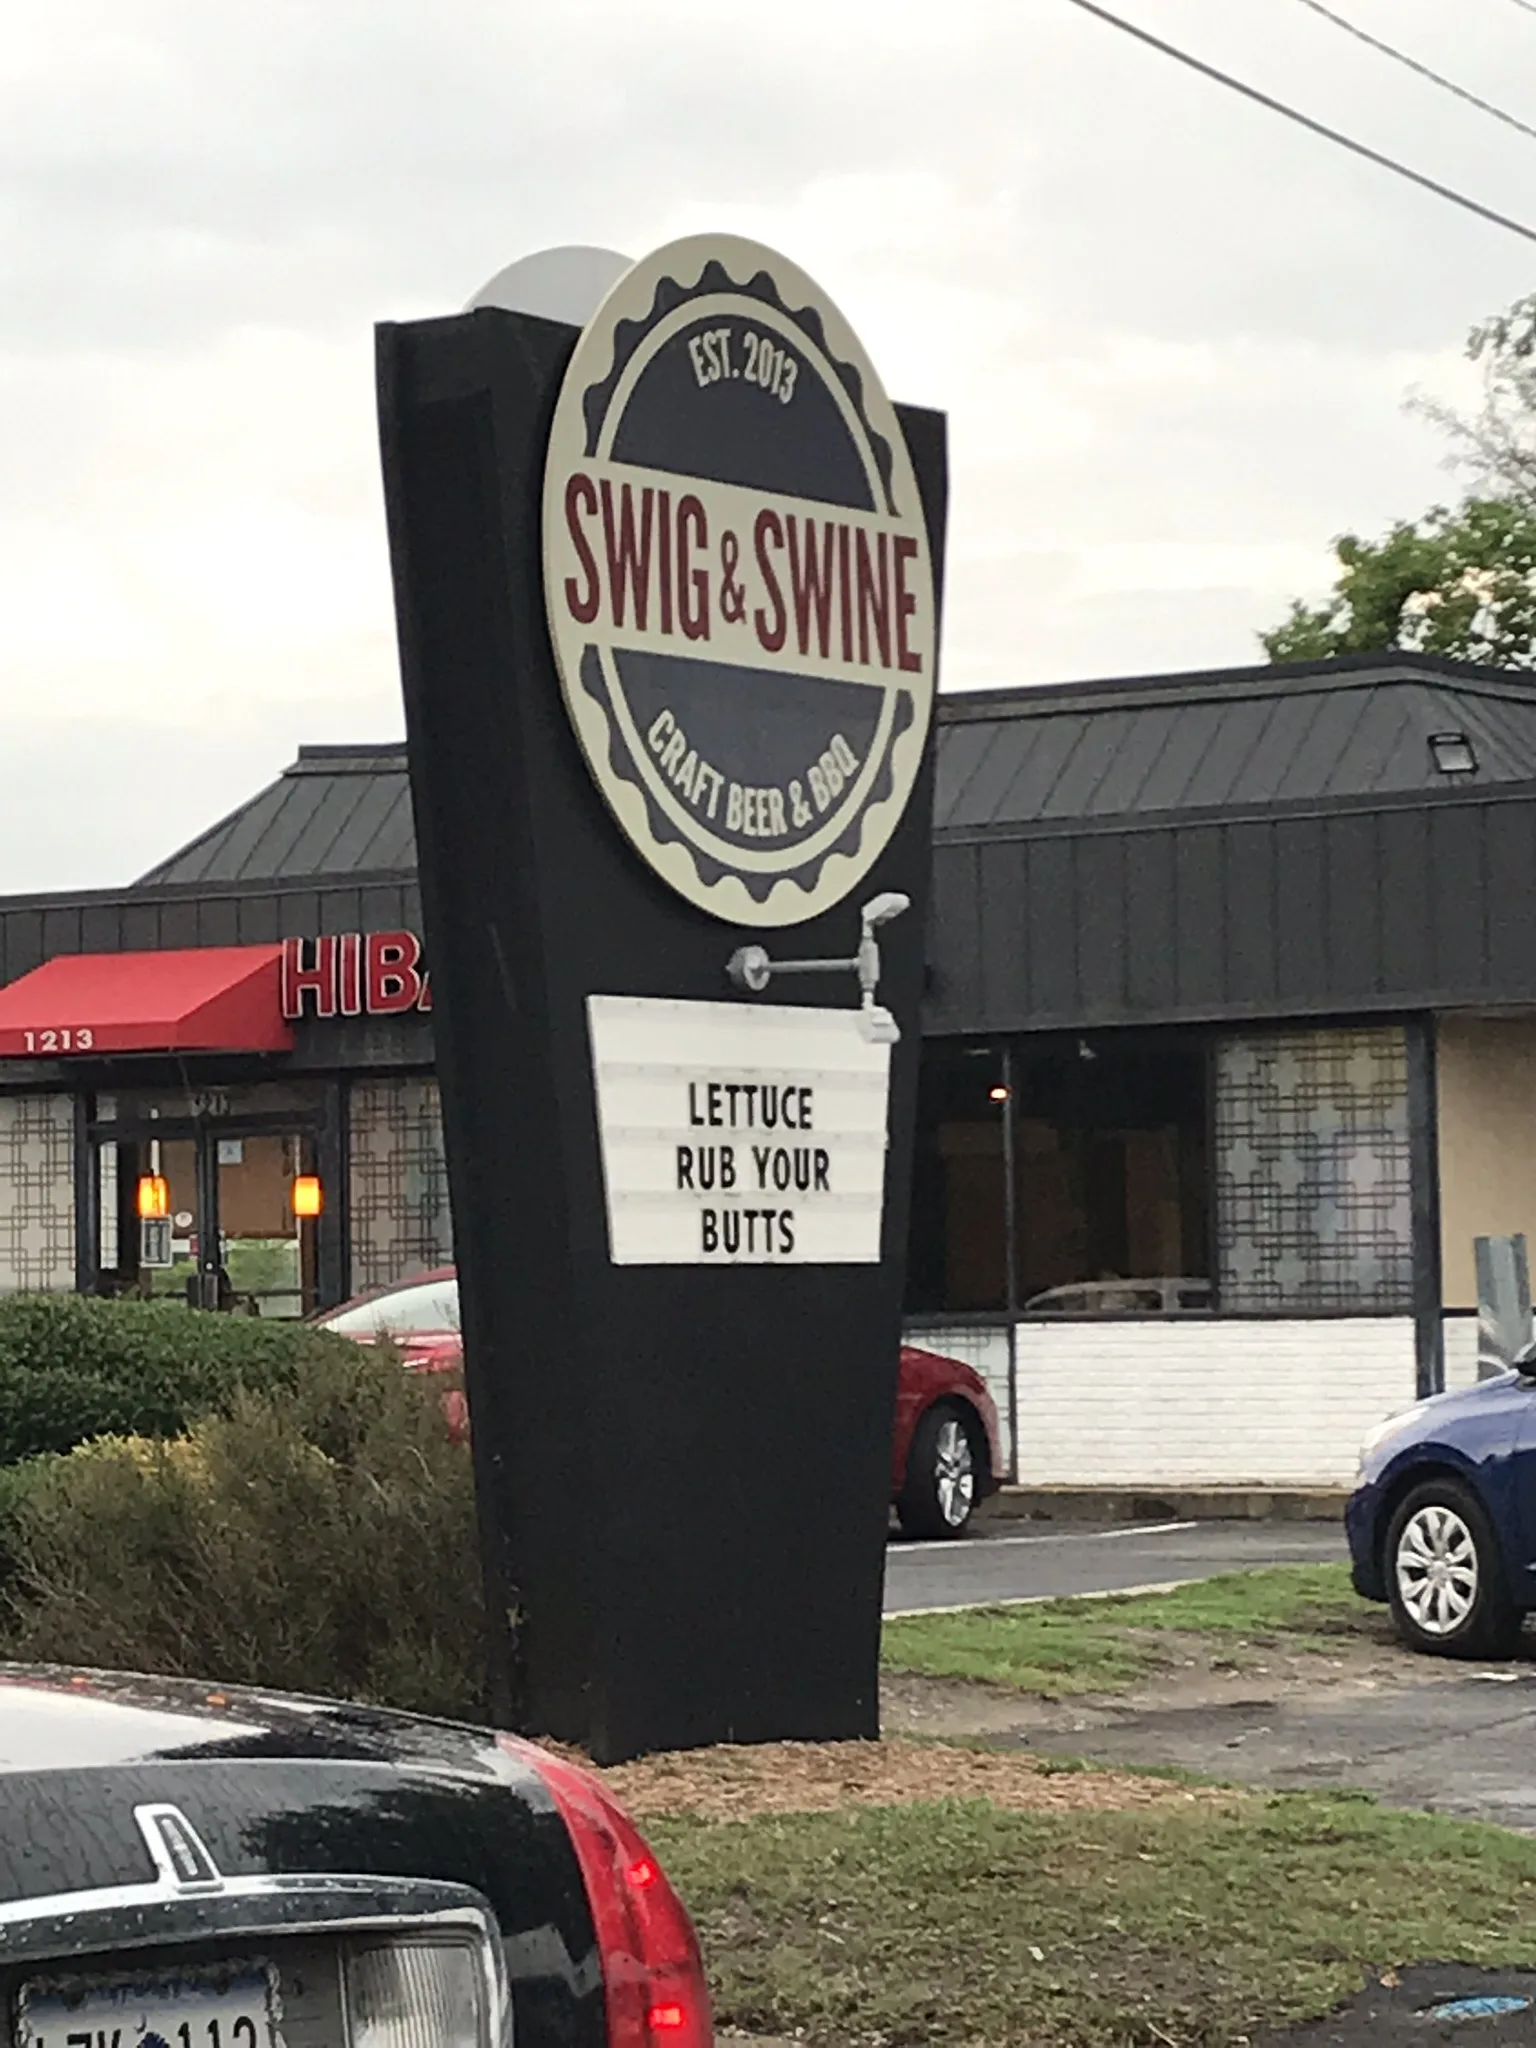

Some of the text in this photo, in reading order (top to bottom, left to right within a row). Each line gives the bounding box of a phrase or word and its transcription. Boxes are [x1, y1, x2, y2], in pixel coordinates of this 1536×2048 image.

[689, 329, 799, 405] EST. 2013
[565, 473, 922, 673] SWIG & SWINE
[648, 710, 859, 836] CRAFT BEER & BBQ
[282, 930, 432, 1019] HIB
[23, 1028, 94, 1052] 1213
[689, 1082, 812, 1129] LETTUCE
[676, 1145, 830, 1191] RUB YOUR
[701, 1208, 795, 1253] BUTTS
